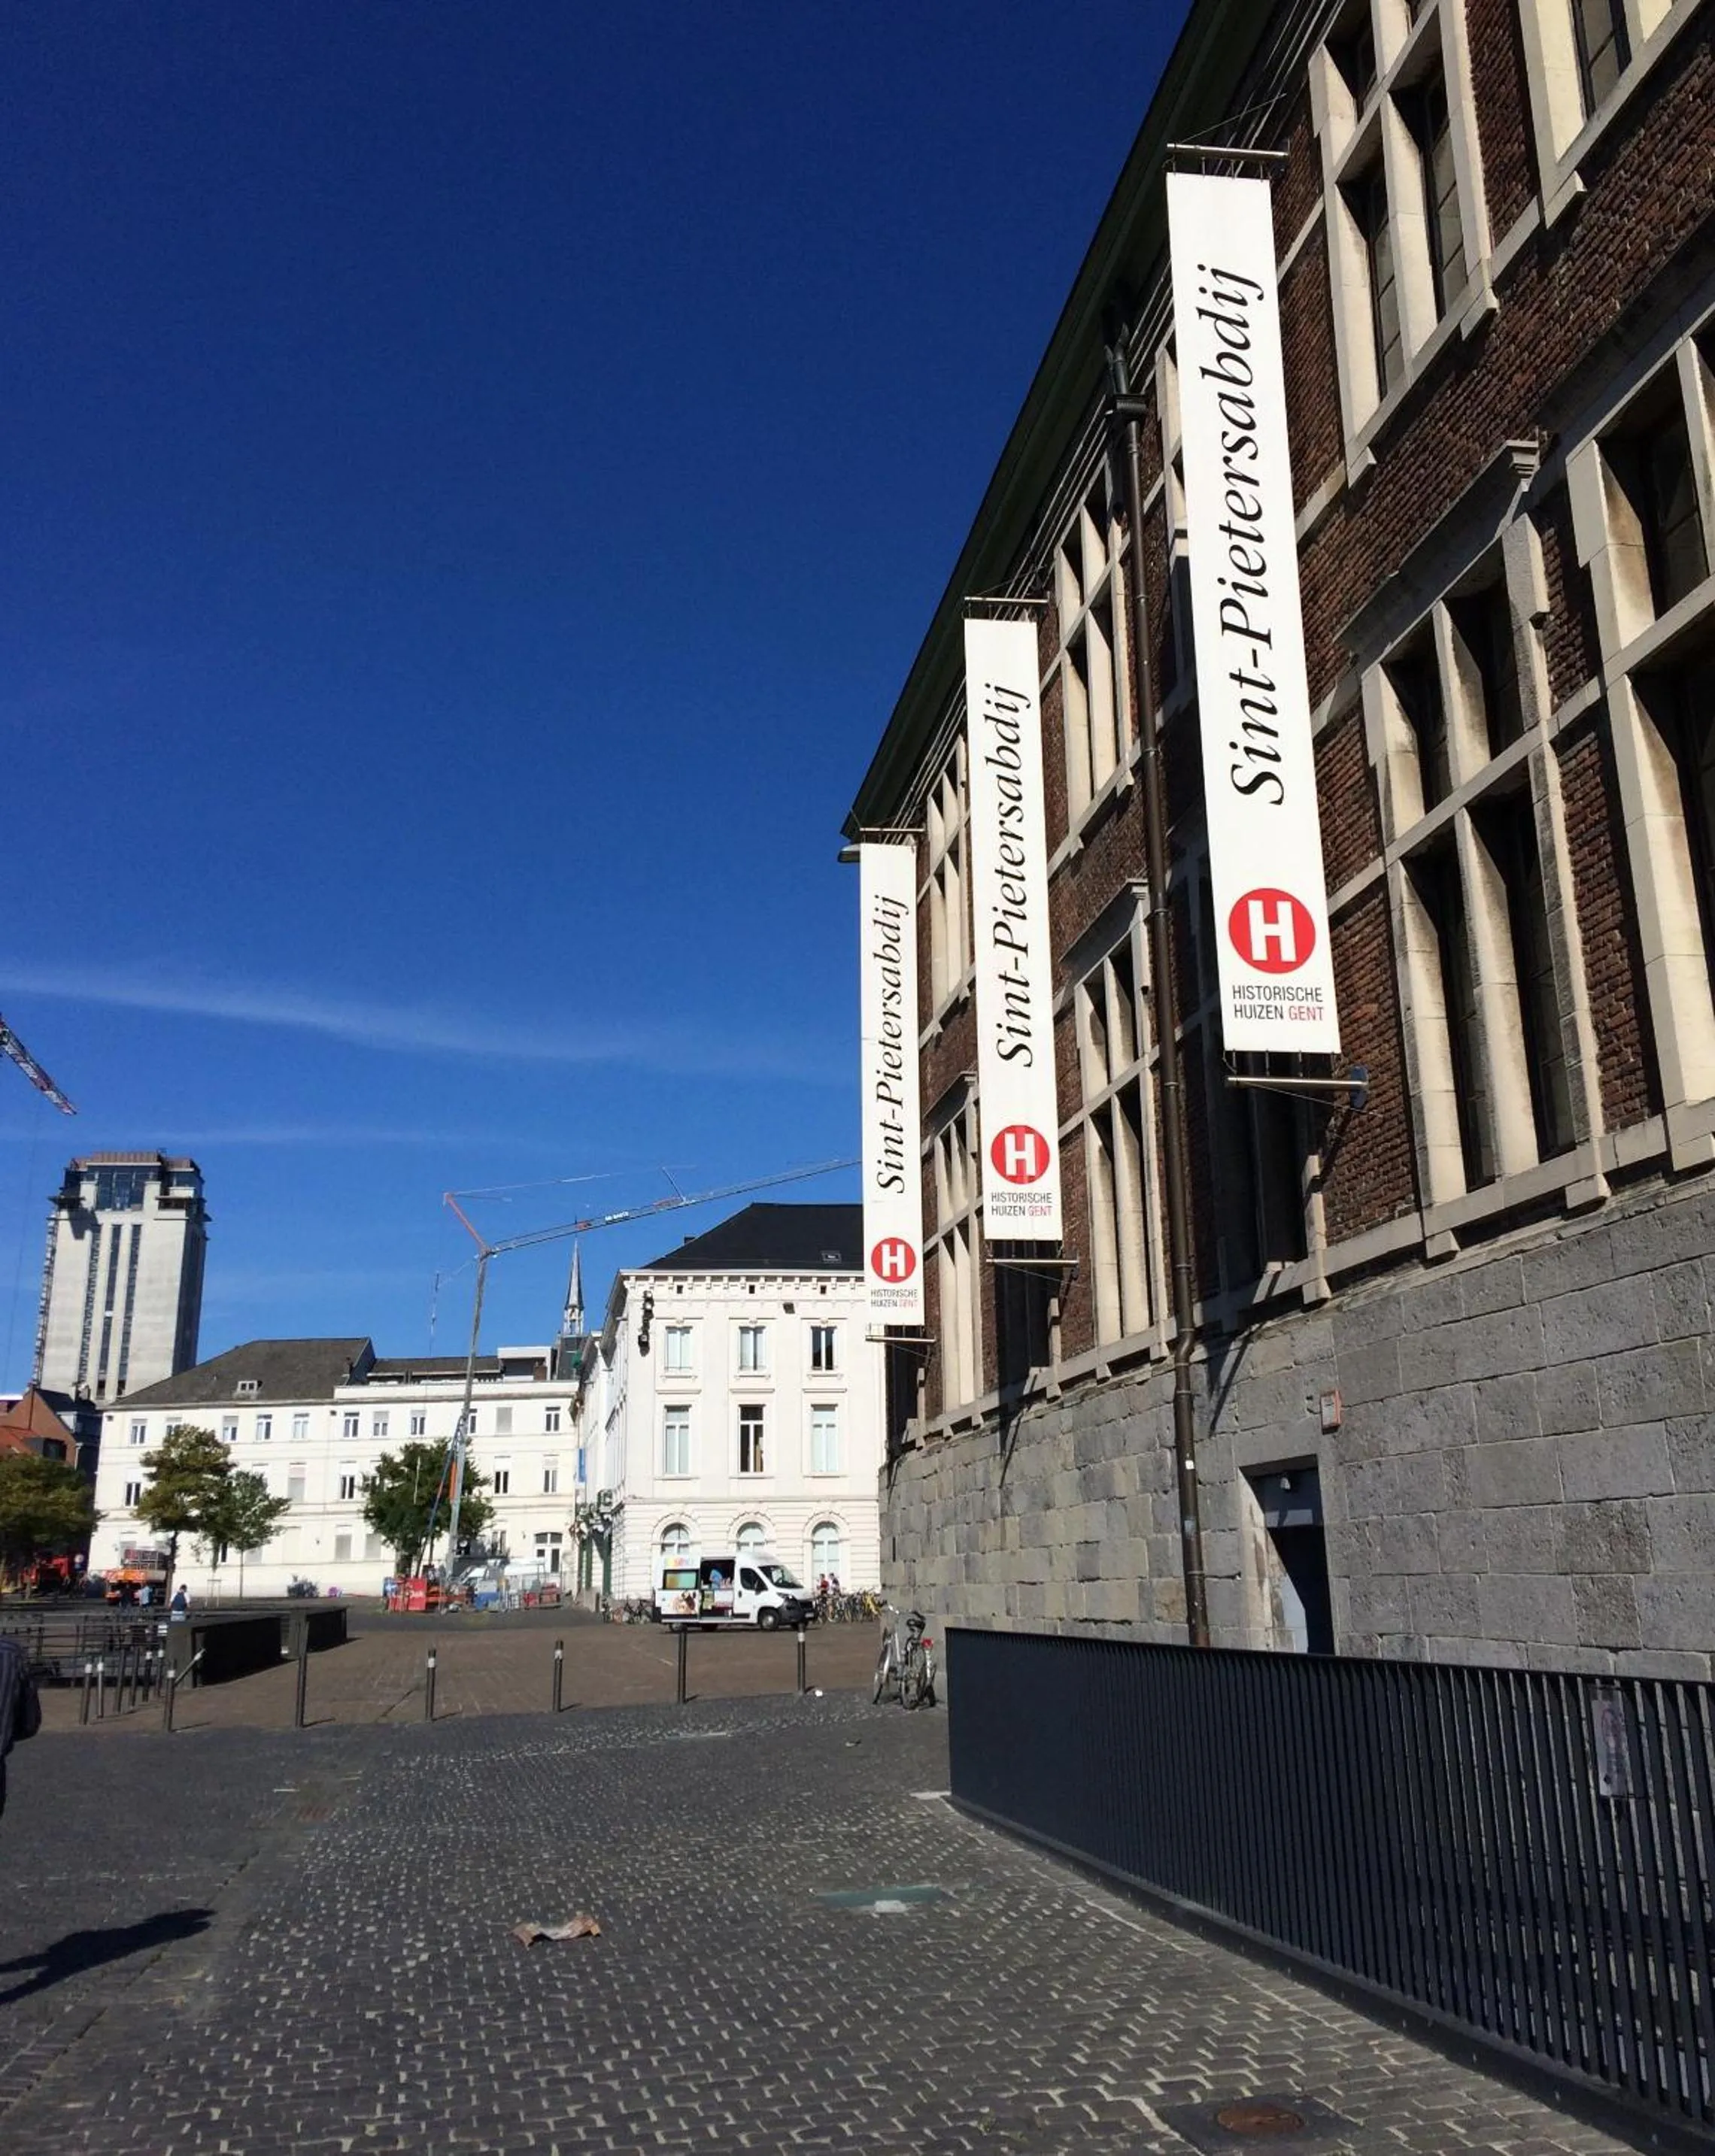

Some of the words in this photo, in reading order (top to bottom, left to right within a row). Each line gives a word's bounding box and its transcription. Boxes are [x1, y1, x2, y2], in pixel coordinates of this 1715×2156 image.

[1195, 263, 1285, 806] Sint-Pietersabdij
[983, 683, 1034, 1068] Sint-Pietersabdij
[1247, 899, 1298, 962] H
[1232, 984, 1324, 1002] HISTORISCHE
[1234, 1004, 1284, 1020] HUIZEN
[1288, 1005, 1325, 1021] GENT
[872, 894, 909, 1194] Sint-Pietersabdij
[1004, 1133, 1037, 1176] H
[991, 1192, 1053, 1203] HISTORISCHE
[991, 1205, 1025, 1216] HUIZEN
[1027, 1205, 1053, 1217] GENT
[882, 1244, 906, 1277] H
